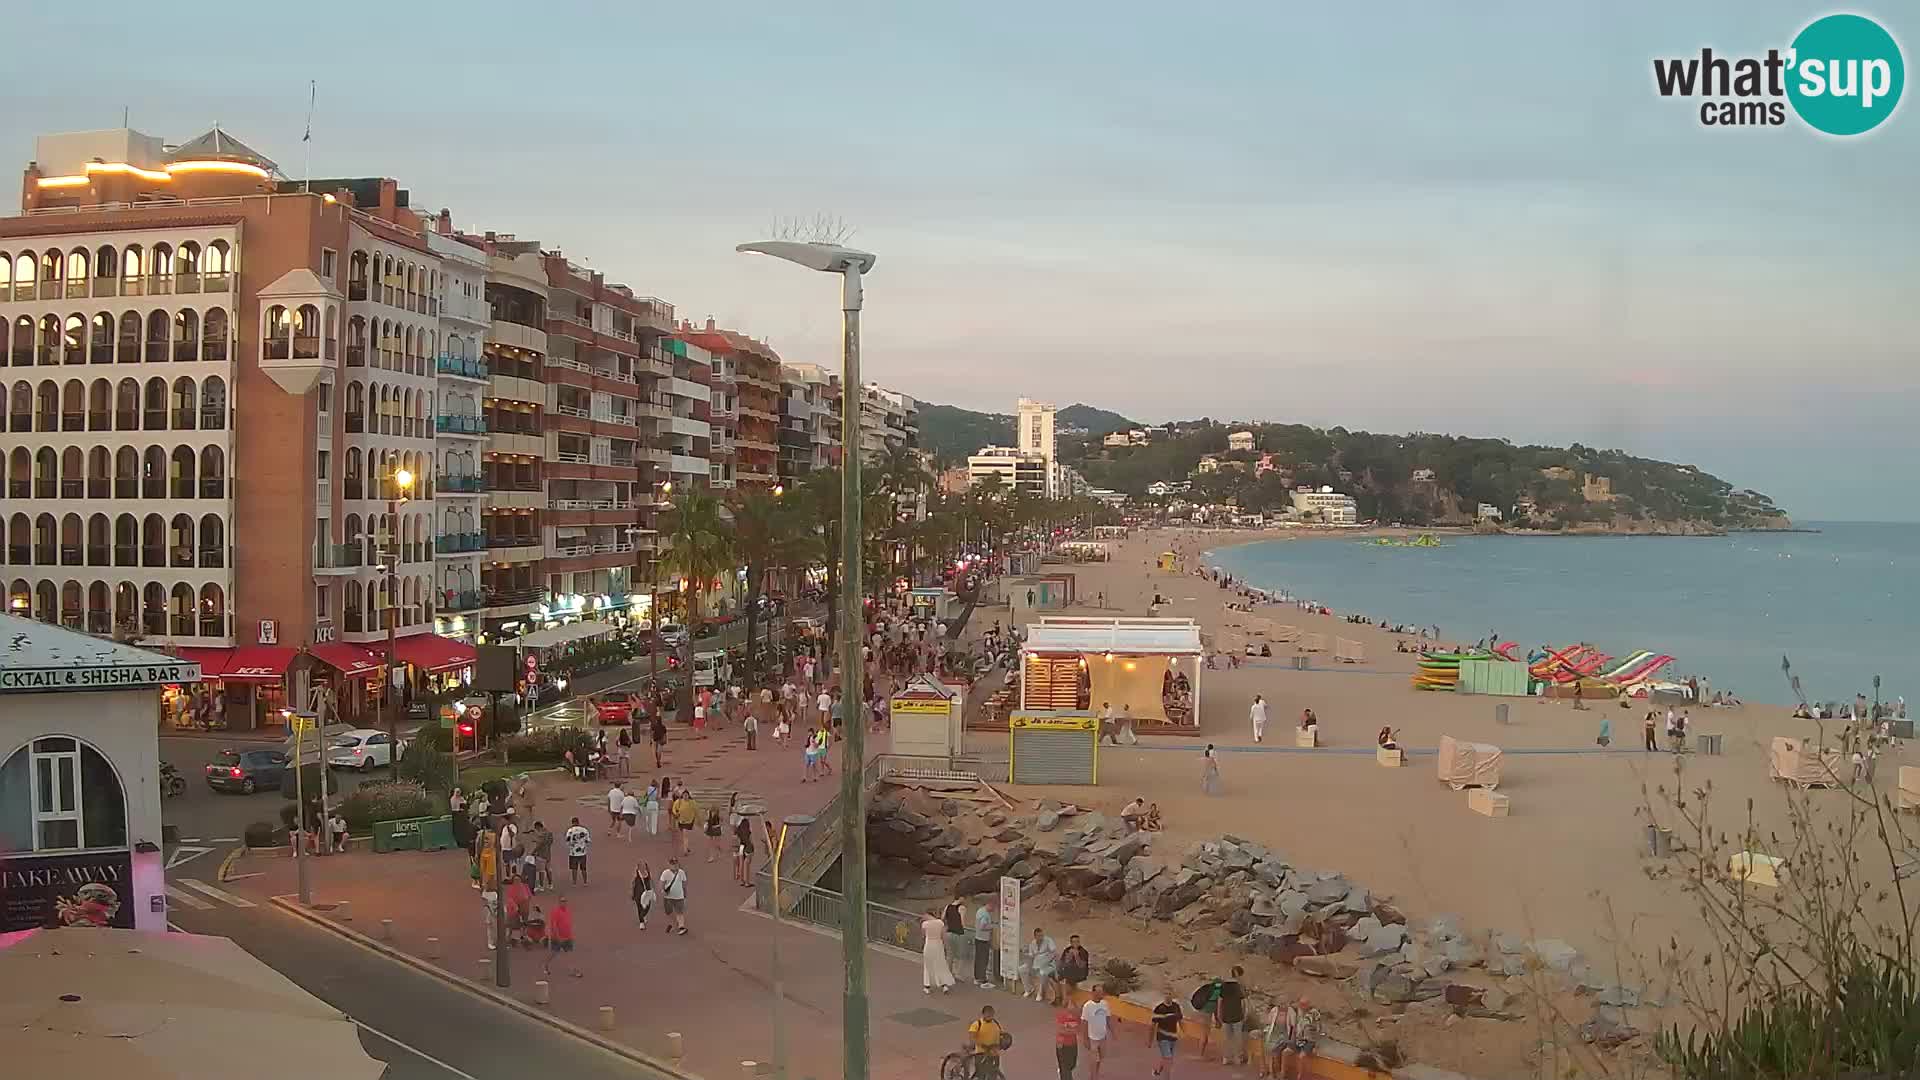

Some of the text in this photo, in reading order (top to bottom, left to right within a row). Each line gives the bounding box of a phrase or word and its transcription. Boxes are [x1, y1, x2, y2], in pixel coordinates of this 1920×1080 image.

[315, 627, 335, 643] KFC
[65, 670, 76, 684] &
[81, 668, 143, 684] SHISHA
[148, 667, 180, 681] BAR
